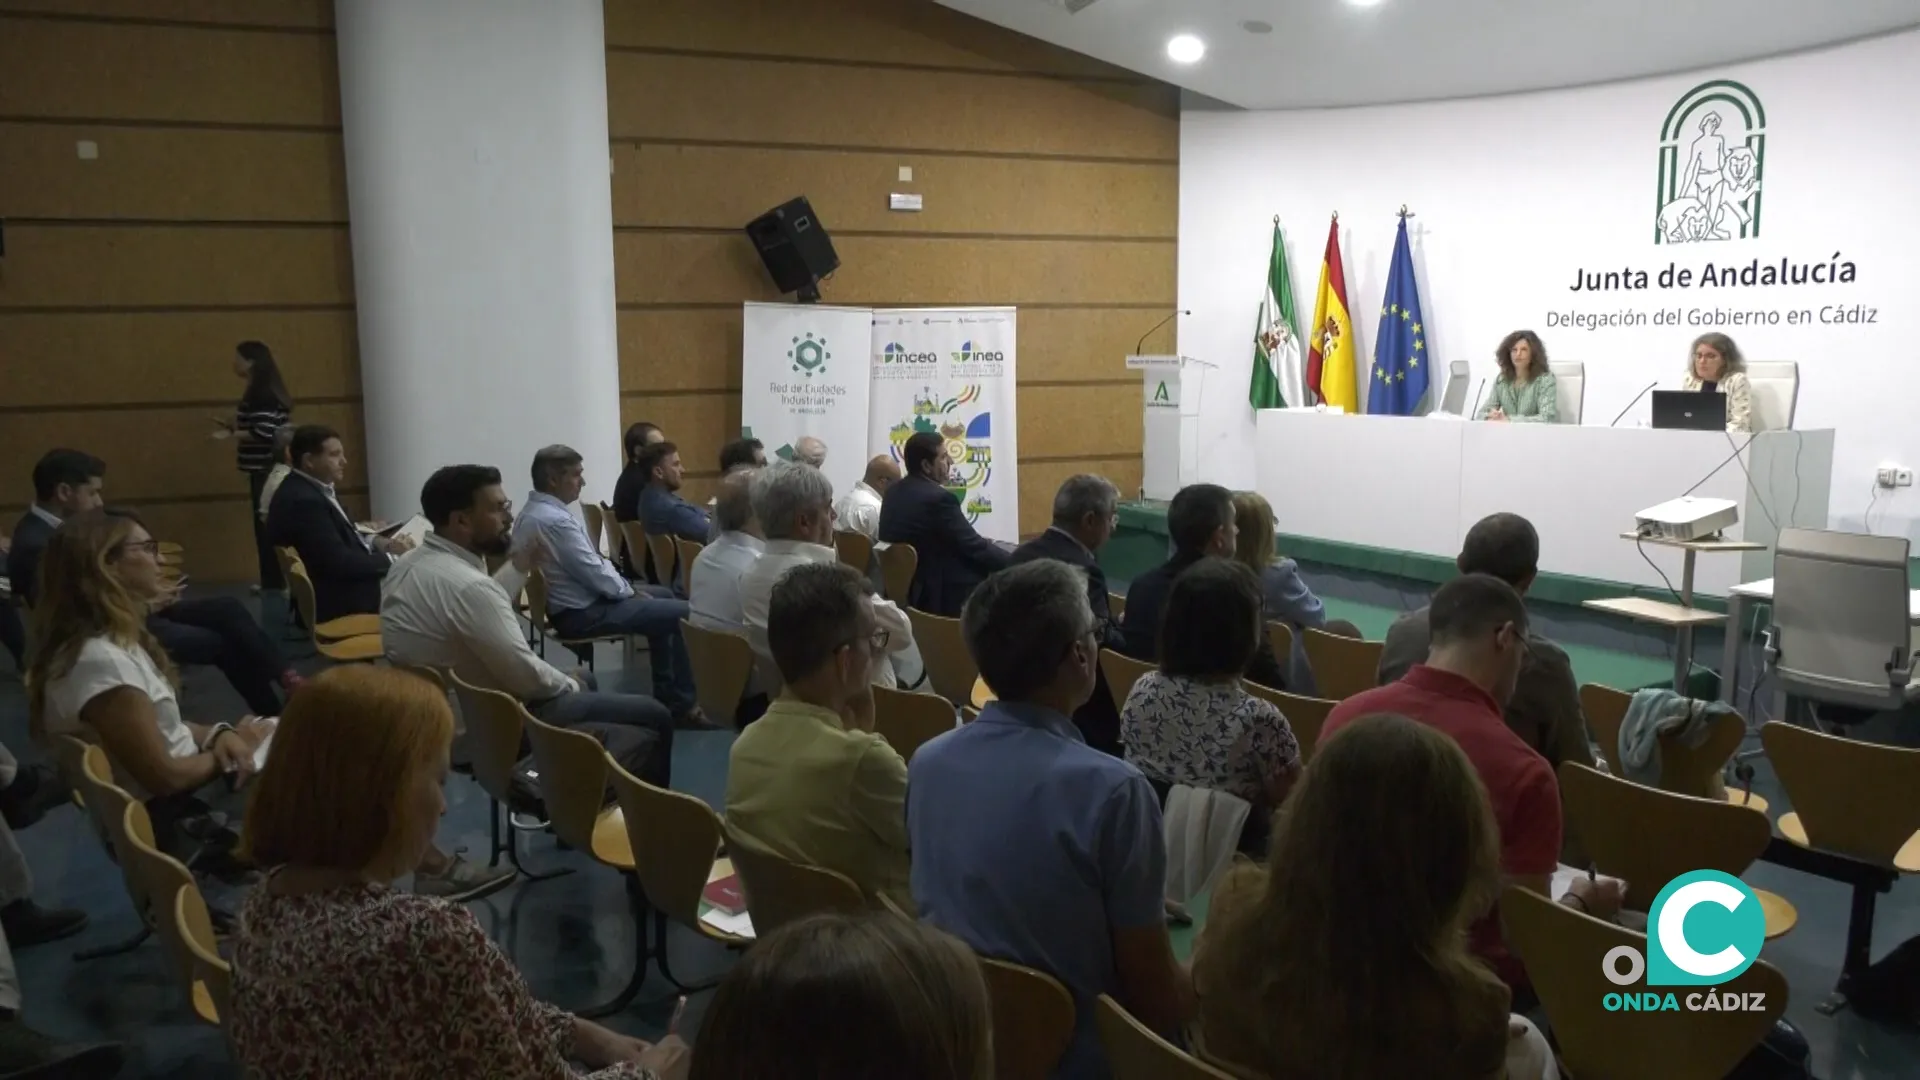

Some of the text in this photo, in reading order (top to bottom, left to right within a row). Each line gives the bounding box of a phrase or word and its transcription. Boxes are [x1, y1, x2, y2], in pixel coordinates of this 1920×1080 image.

[1570, 251, 1857, 292] Junta de Andalucía
[1547, 304, 1879, 331] Delegación del Gobierno en Cádiz
[769, 382, 846, 396] Red de Ciudades
[780, 394, 835, 407] Industriales
